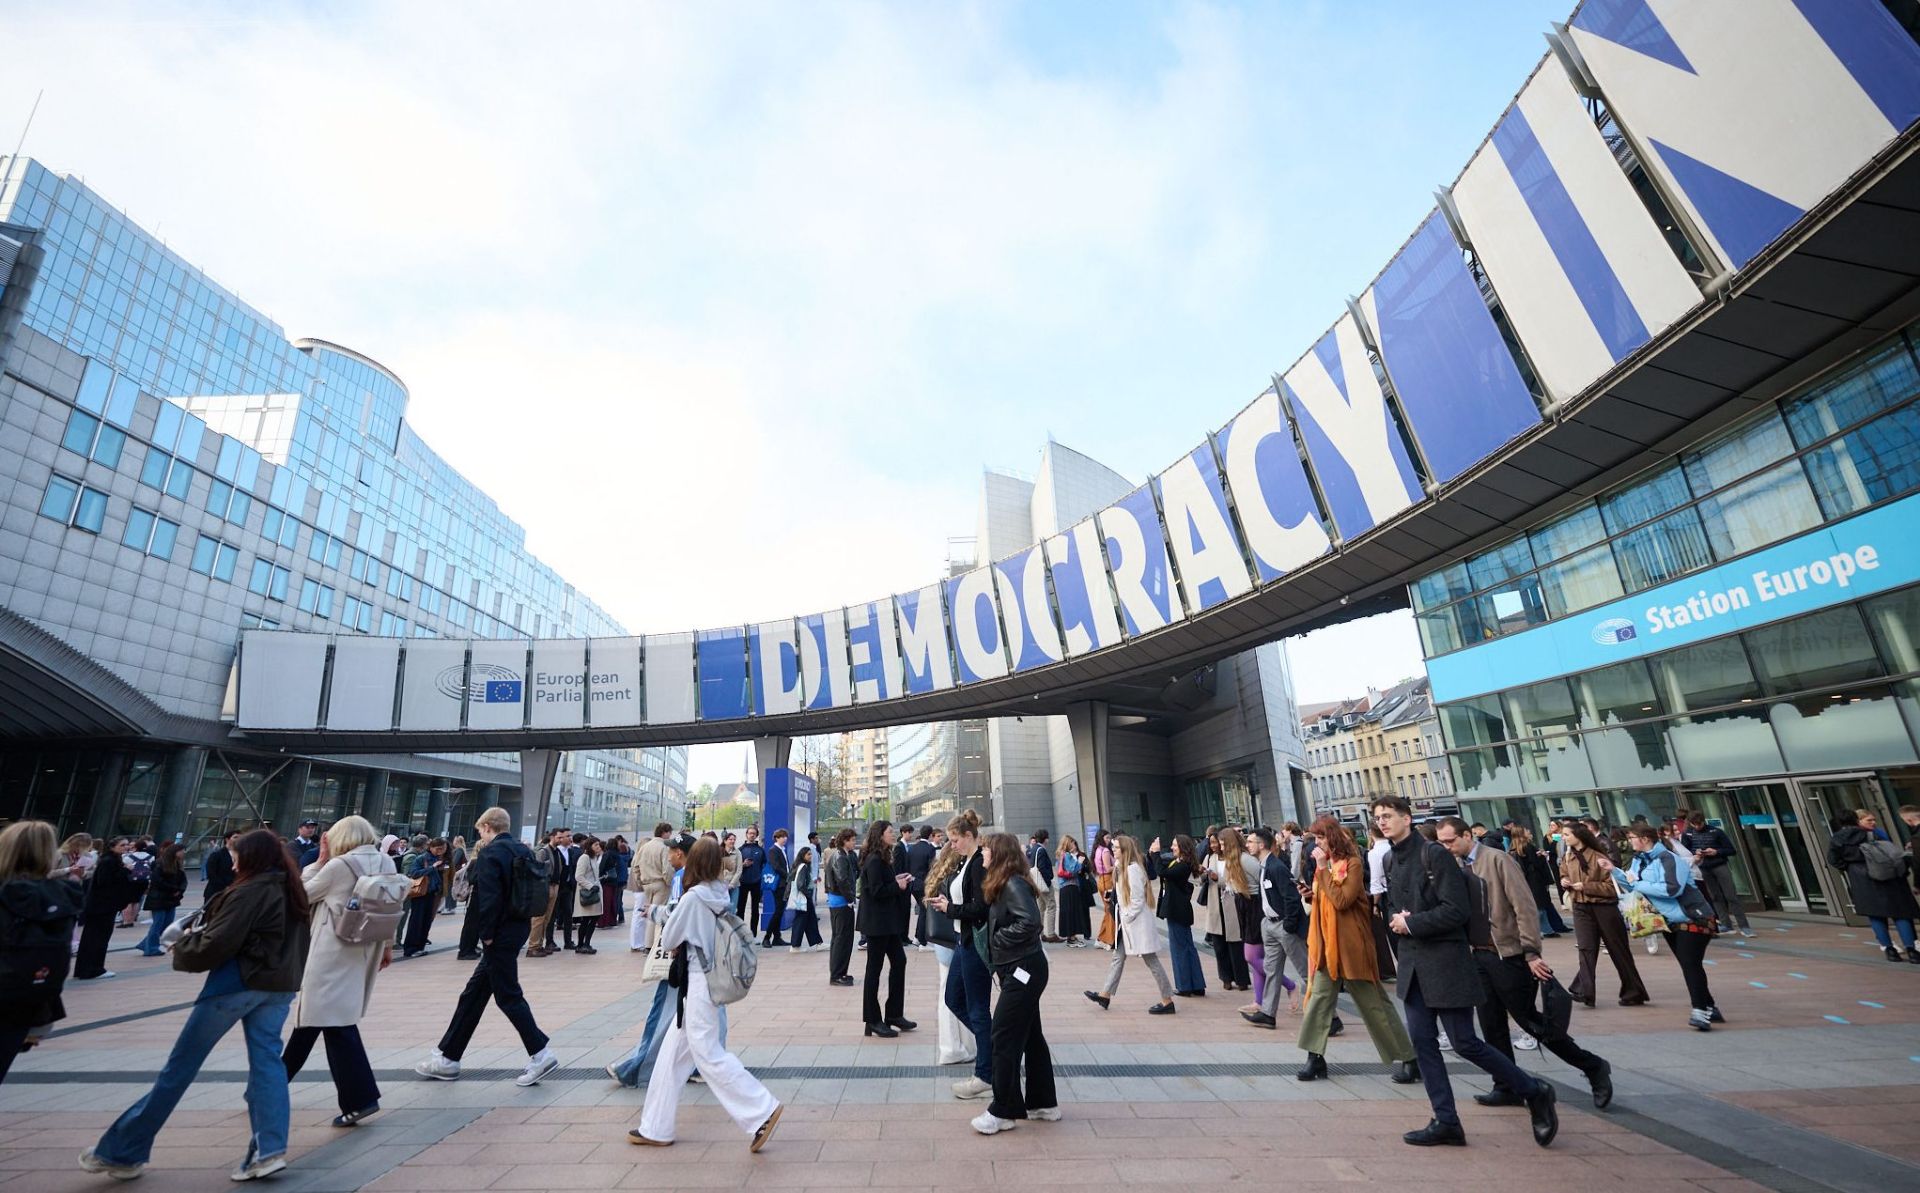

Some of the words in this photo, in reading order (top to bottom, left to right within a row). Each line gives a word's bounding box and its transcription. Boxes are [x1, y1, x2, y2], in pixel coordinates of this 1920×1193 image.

[757, 285, 1413, 717] DEMOCRACY
[1451, 0, 1901, 404] IN
[1645, 585, 1750, 633] Station
[1752, 544, 1880, 602] Europe
[535, 687, 632, 702] Parliament
[536, 672, 619, 687] European
